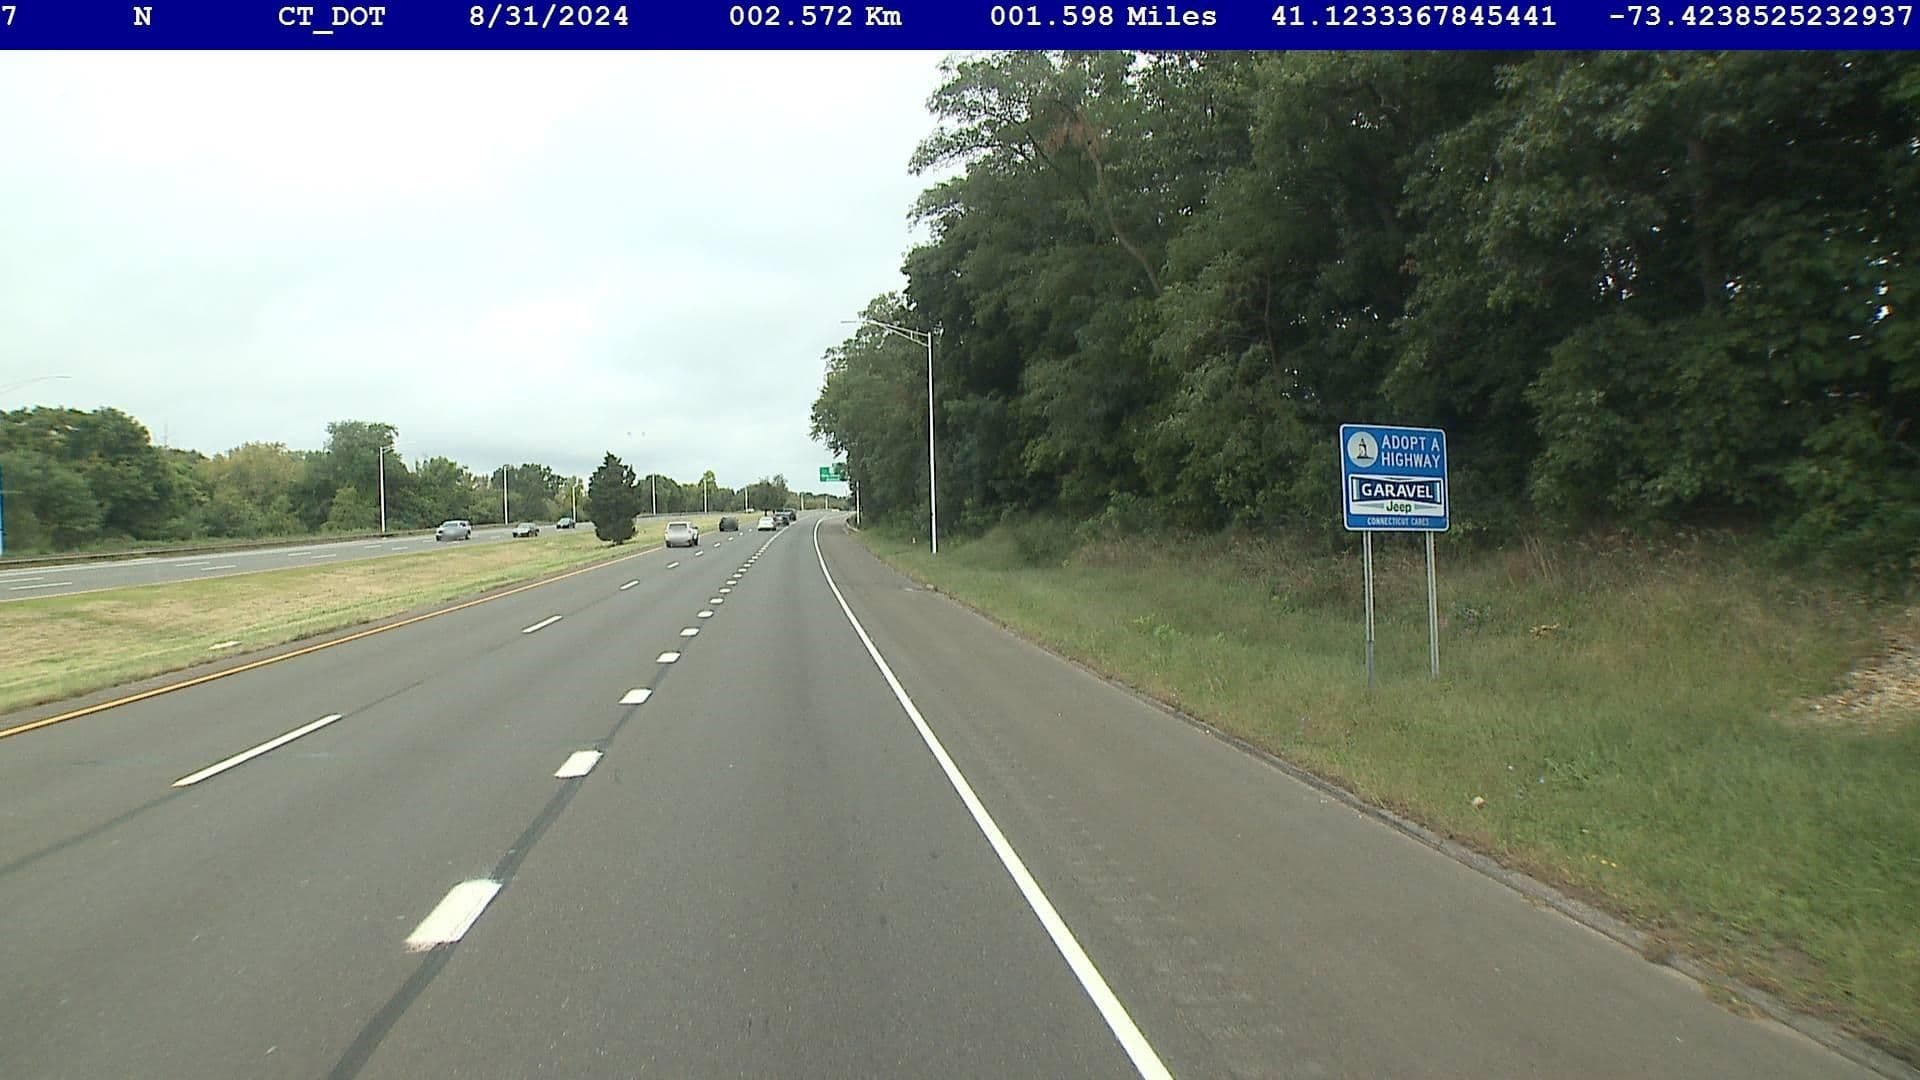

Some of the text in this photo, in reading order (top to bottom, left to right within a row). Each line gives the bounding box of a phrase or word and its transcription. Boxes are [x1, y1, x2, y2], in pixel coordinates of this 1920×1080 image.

[1381, 434, 1440, 452] ADOPT A
[1381, 451, 1440, 469] HIGHWAY
[1361, 483, 1433, 499] GARAVEL
[1386, 500, 1412, 514] Jeep
